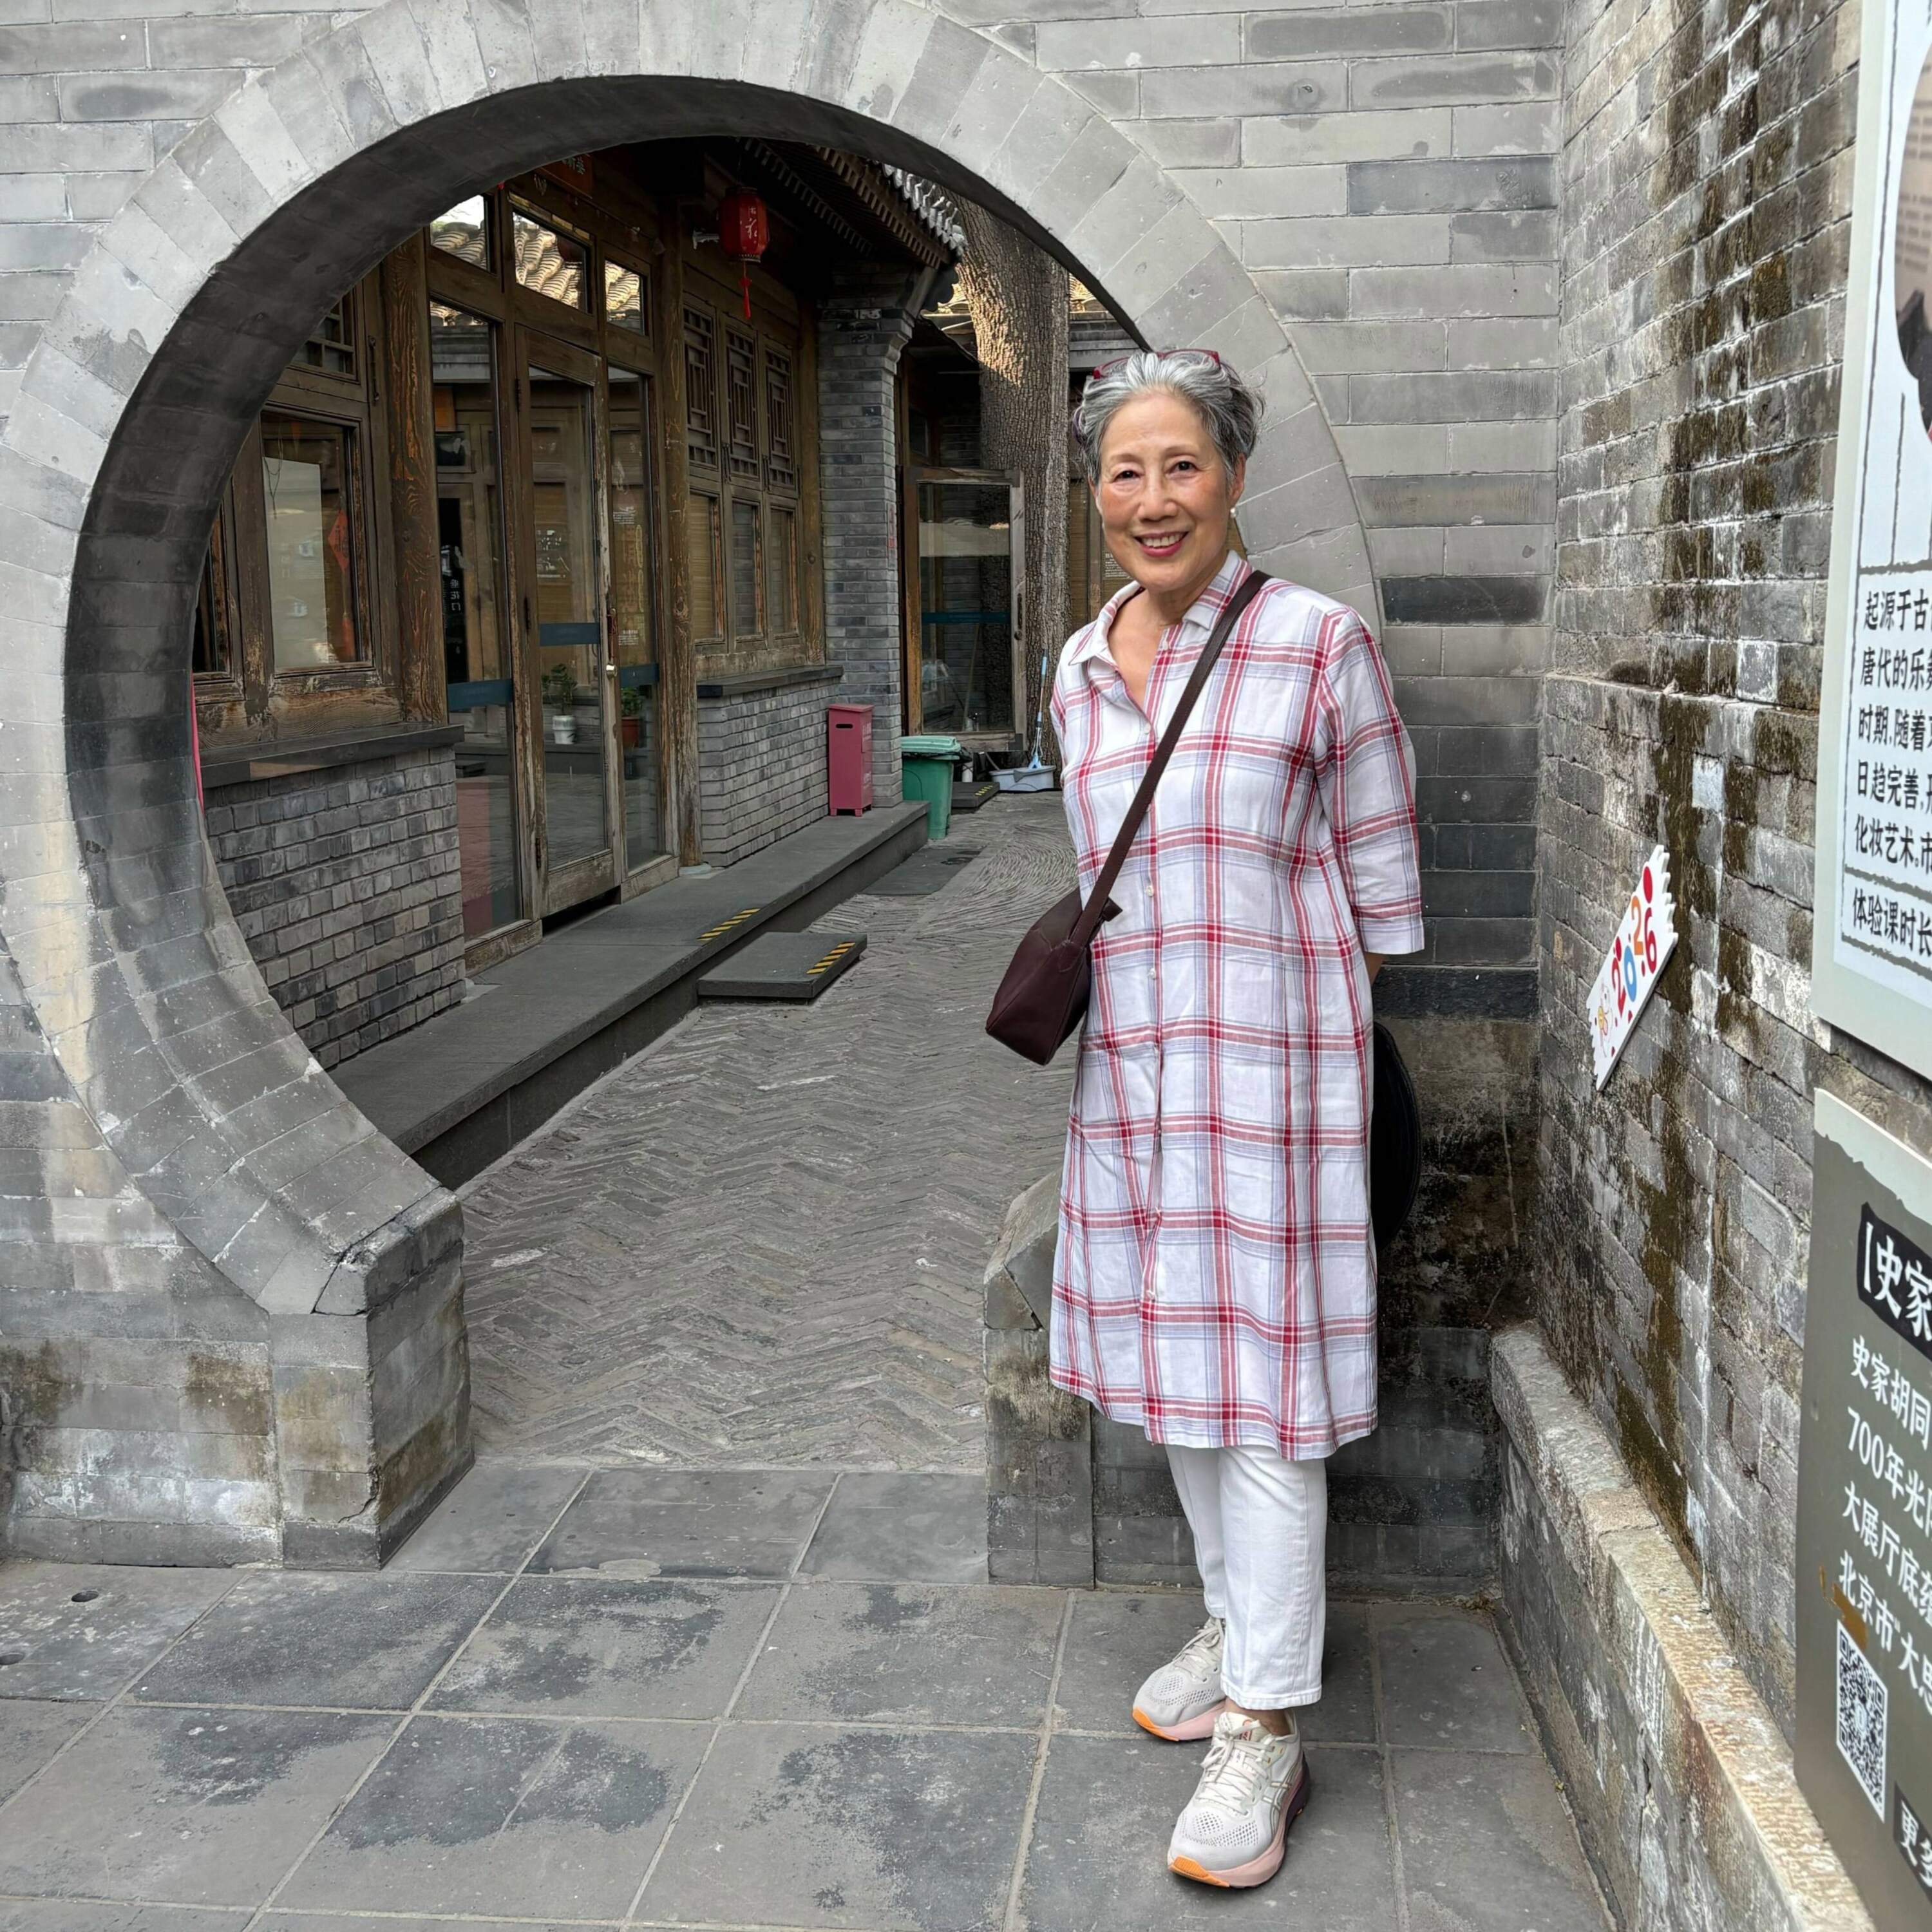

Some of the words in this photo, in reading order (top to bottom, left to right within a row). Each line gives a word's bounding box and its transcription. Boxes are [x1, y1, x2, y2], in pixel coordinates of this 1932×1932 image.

[1864, 588, 1932, 632] 起源于古
[1859, 703, 1932, 752] 时期，随着
[1853, 886, 1932, 958] 体验课时长
[1850, 1334, 1931, 1452] 史家胡同
